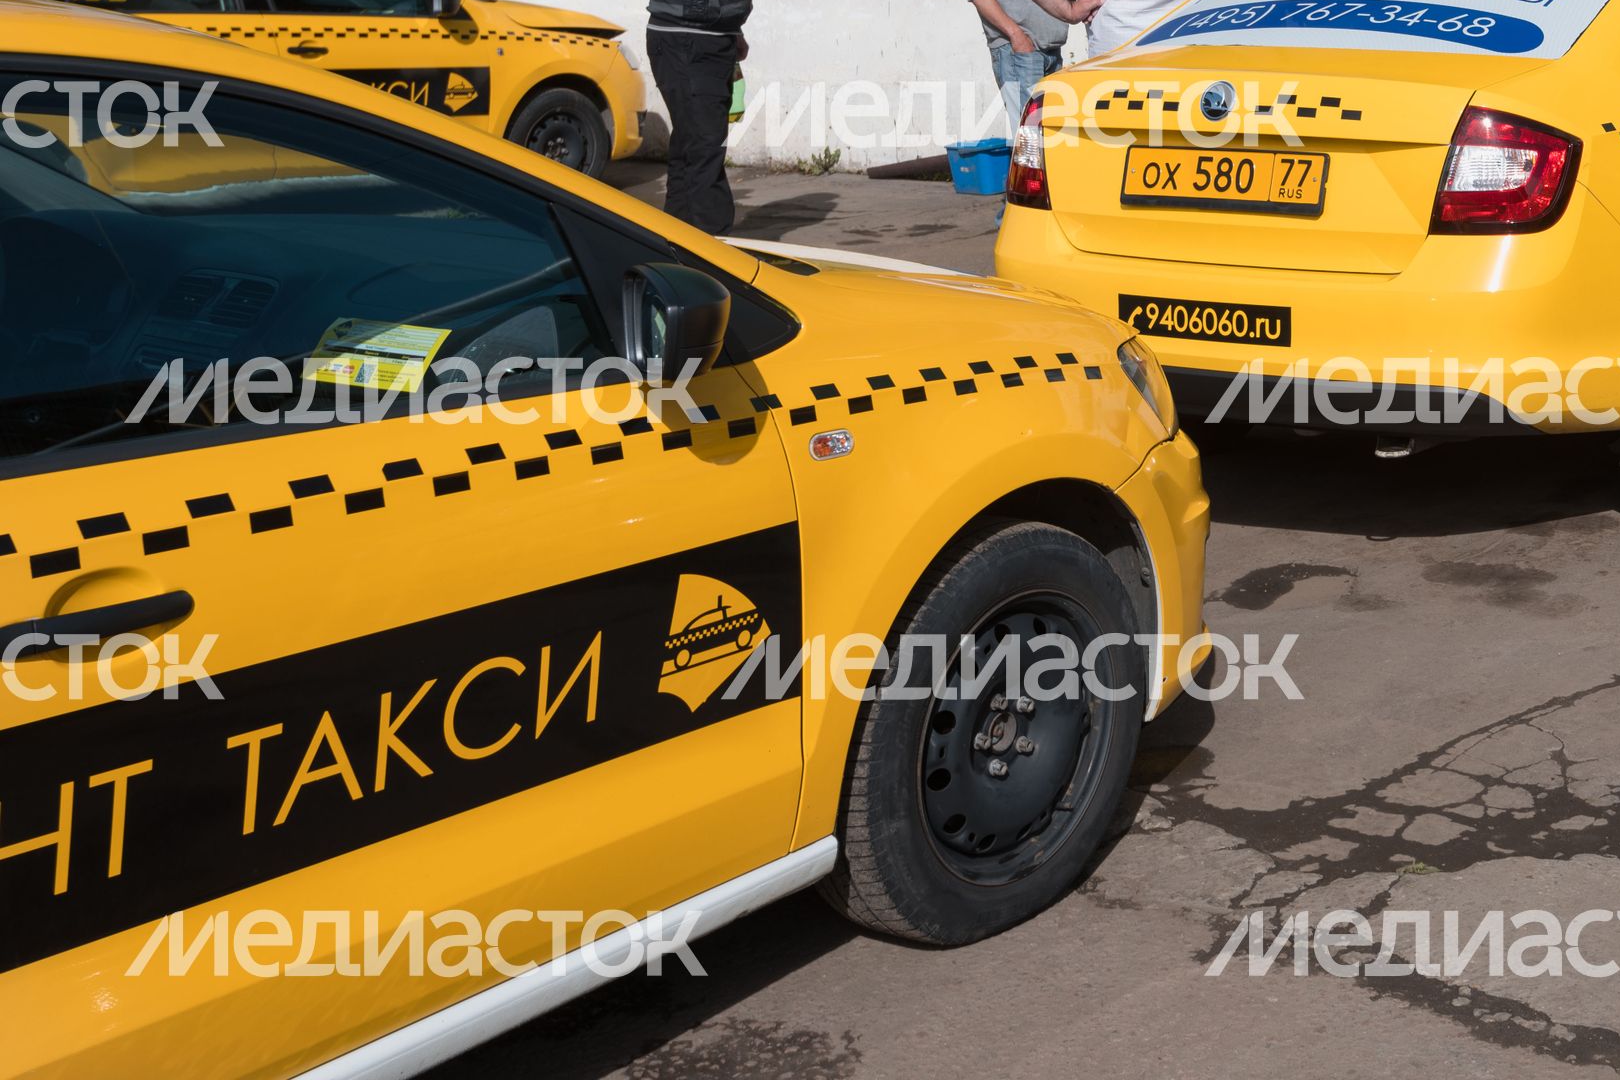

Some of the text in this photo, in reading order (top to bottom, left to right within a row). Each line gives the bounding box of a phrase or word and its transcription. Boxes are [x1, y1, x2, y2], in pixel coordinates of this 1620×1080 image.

[1169, 1, 1496, 38] (495) 767-34-68
[1192, 156, 1255, 194] 580
[1280, 158, 1313, 188] 77
[1278, 188, 1303, 199] RUS
[1145, 302, 1281, 340] 9406060.ru
[226, 631, 602, 835] ТАКСИ
